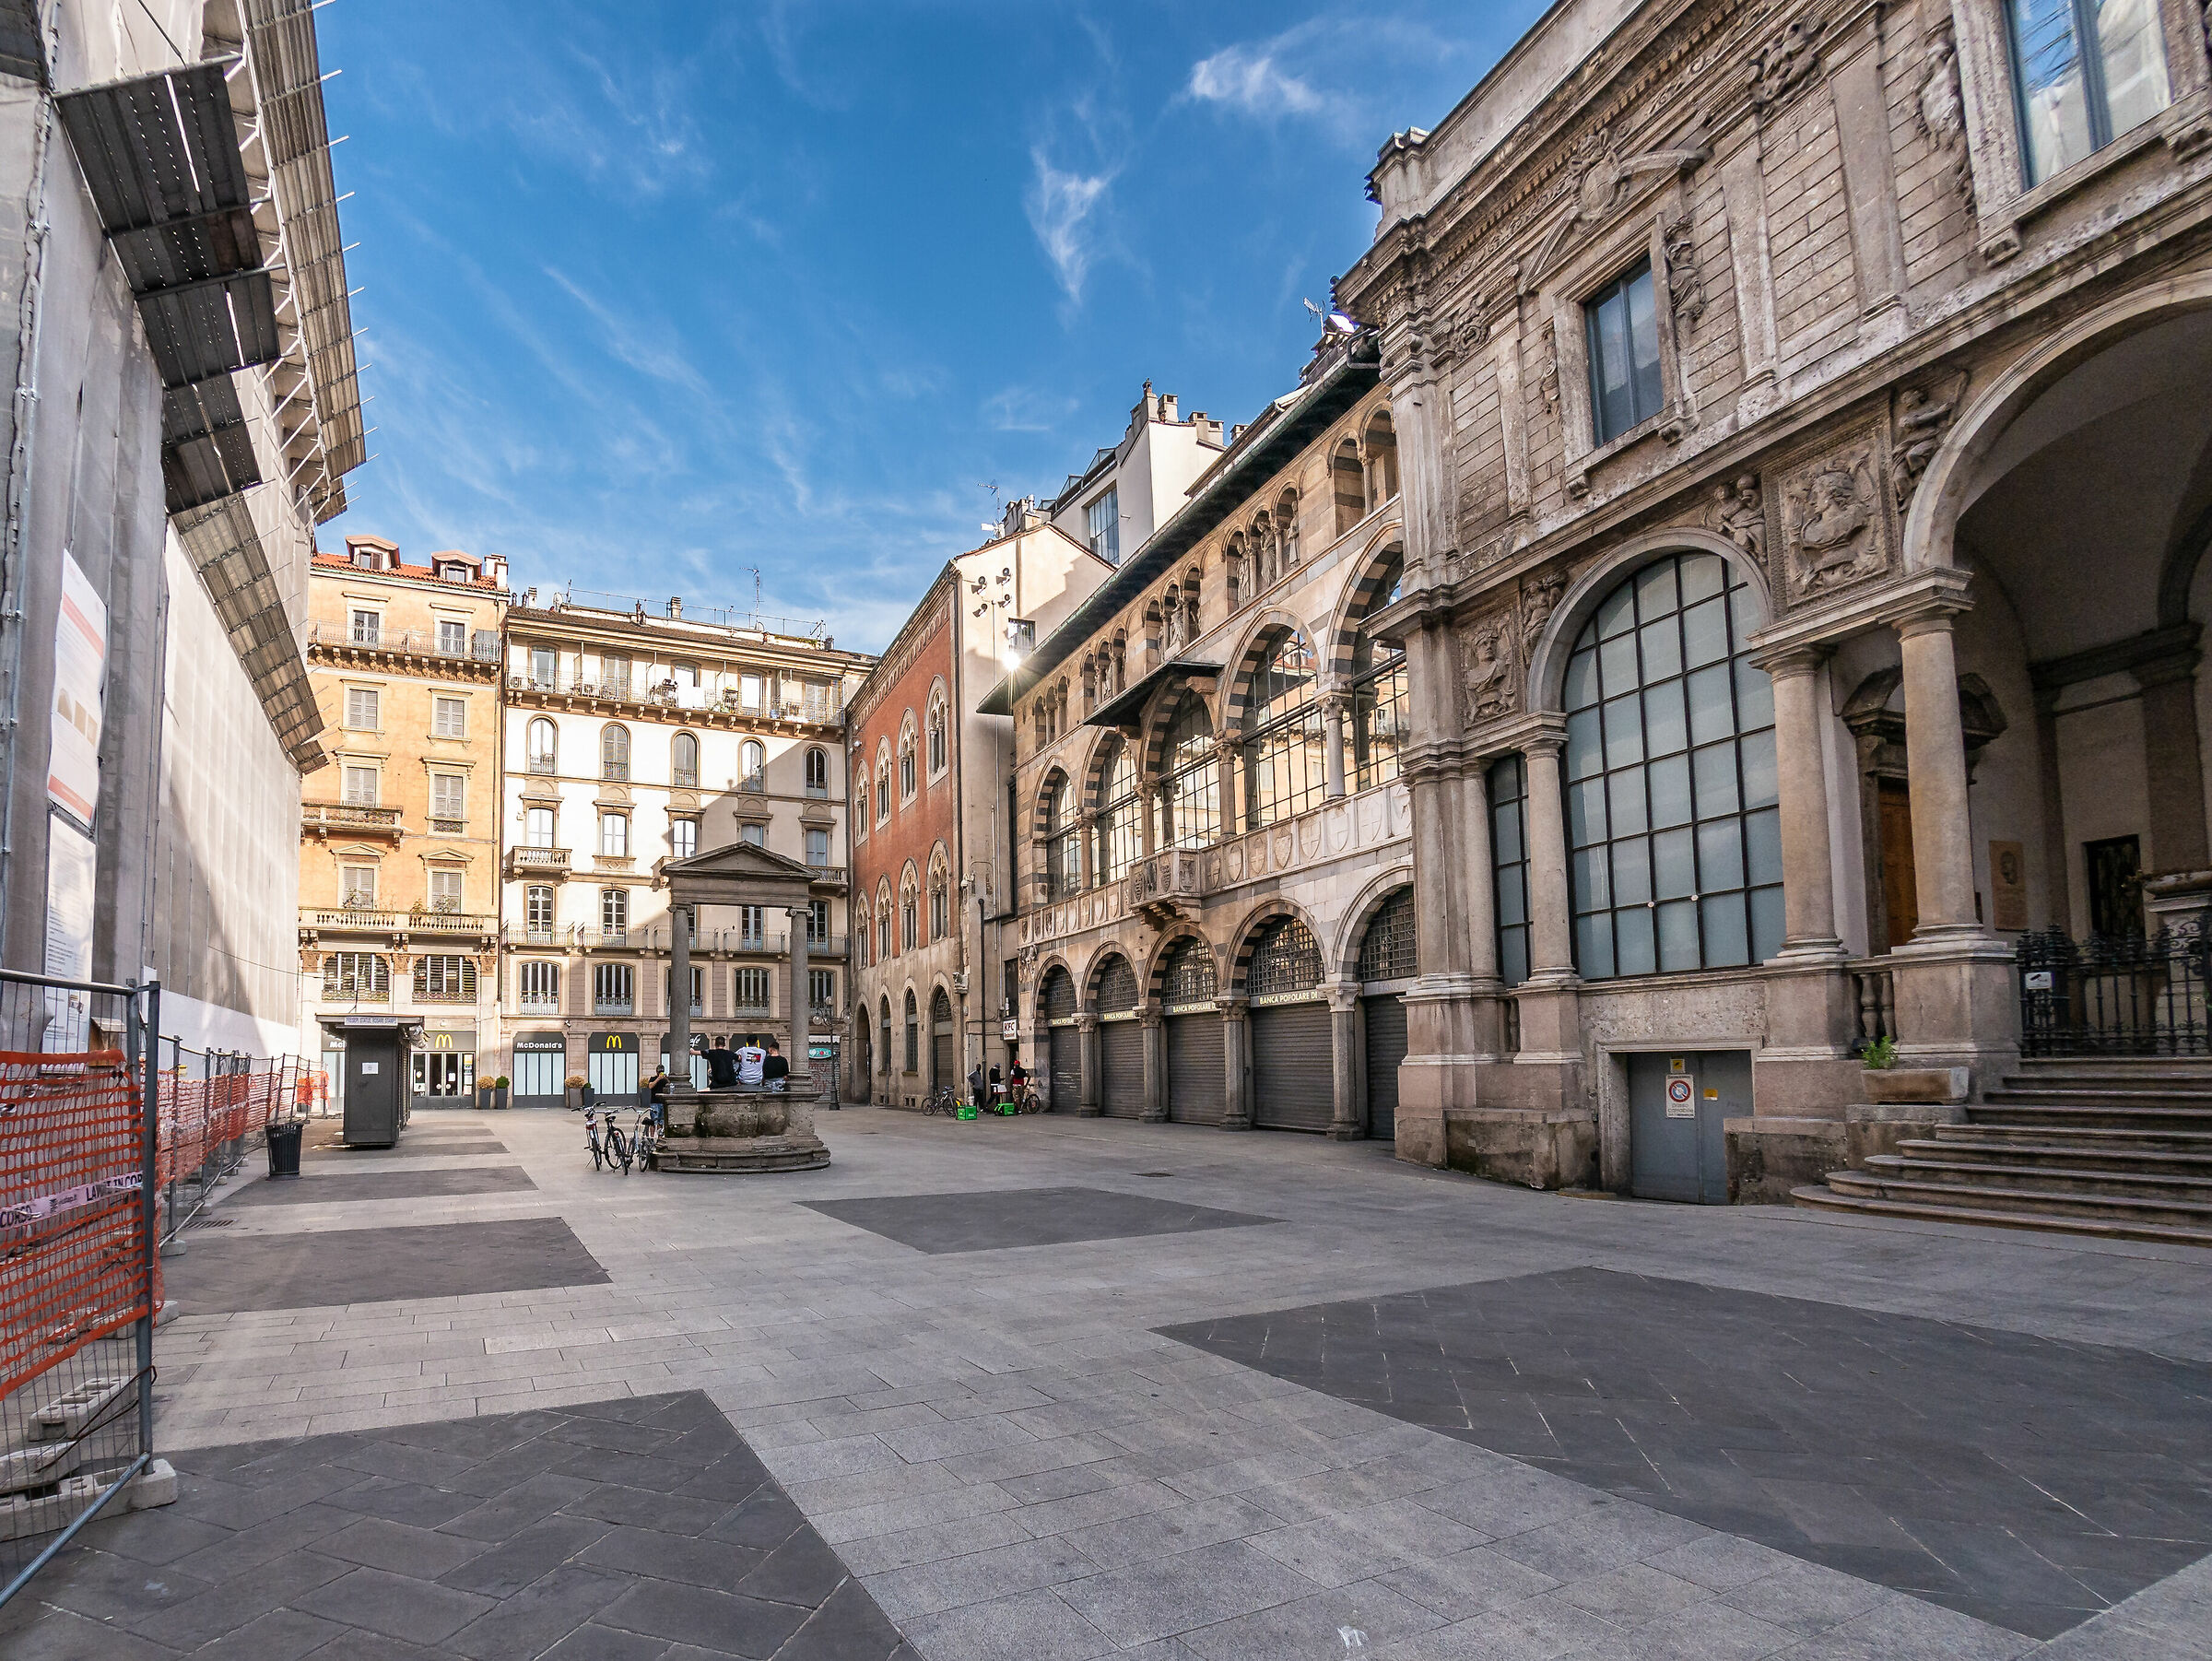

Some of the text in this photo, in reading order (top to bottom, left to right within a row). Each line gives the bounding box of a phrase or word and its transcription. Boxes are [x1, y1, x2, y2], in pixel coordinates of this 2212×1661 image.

[1259, 995, 1279, 1005] BANCA
[1279, 992, 1310, 1002] POPOLARE
[1172, 1005, 1187, 1013] BANCA
[1188, 1002, 1211, 1011] POPOLARE
[1004, 1021, 1015, 1031] KFC
[0, 1205, 33, 1228] CORSO
